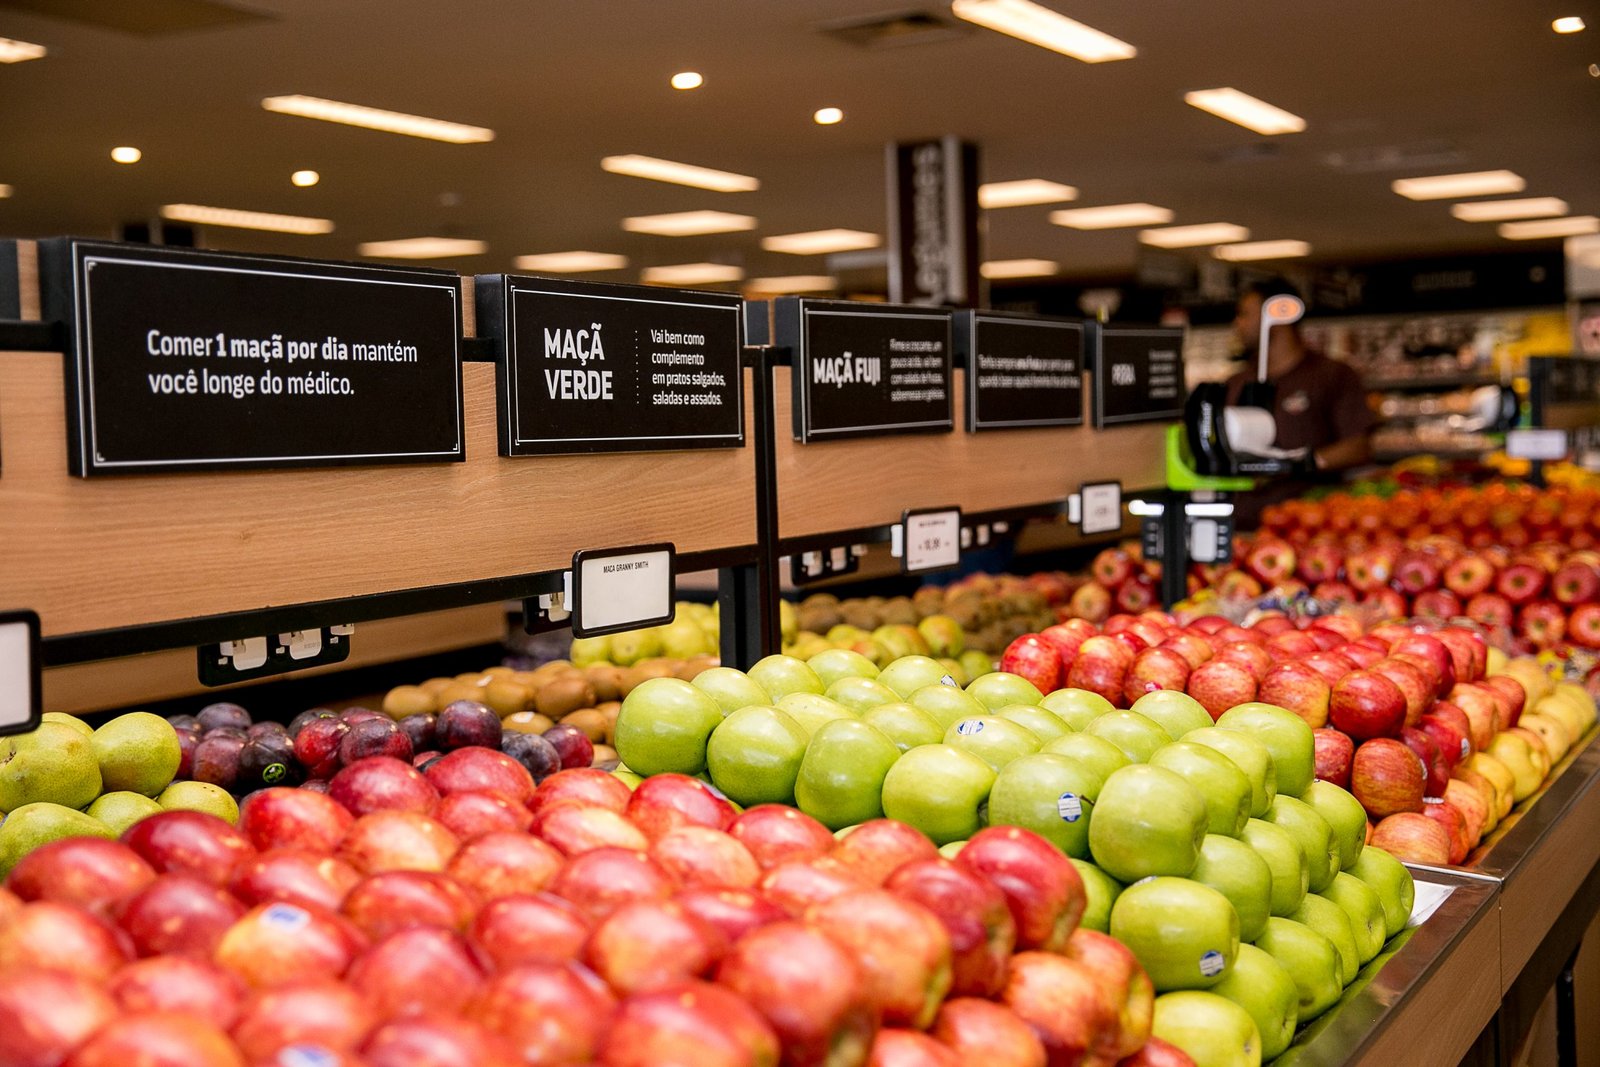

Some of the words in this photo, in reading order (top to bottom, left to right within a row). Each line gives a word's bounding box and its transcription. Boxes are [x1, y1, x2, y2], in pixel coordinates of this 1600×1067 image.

[147, 329, 213, 356] Comer
[216, 333, 227, 358] 1
[230, 334, 283, 362] maçã
[287, 342, 318, 363] por
[322, 336, 348, 360] dia
[352, 340, 418, 362] mantém
[544, 322, 605, 366] MAÇÃ
[651, 329, 664, 344] Vai
[664, 329, 682, 345] bem
[683, 334, 705, 346] como
[651, 350, 705, 367] complemento
[813, 351, 854, 389] MAÇÃ
[855, 357, 881, 387] FUJI
[149, 369, 198, 394] você
[203, 368, 255, 399] longe
[260, 370, 283, 394] do
[287, 371, 355, 395] médico.
[544, 369, 614, 400] VERDE
[652, 373, 666, 385] em
[666, 372, 691, 387] pratos
[692, 371, 726, 388] salgados,
[653, 390, 683, 406] saladas
[683, 394, 689, 405] e
[690, 391, 722, 406] assados.
[603, 565, 616, 573] MACA
[616, 563, 634, 572] GRANNY
[634, 561, 649, 570] SMITH
